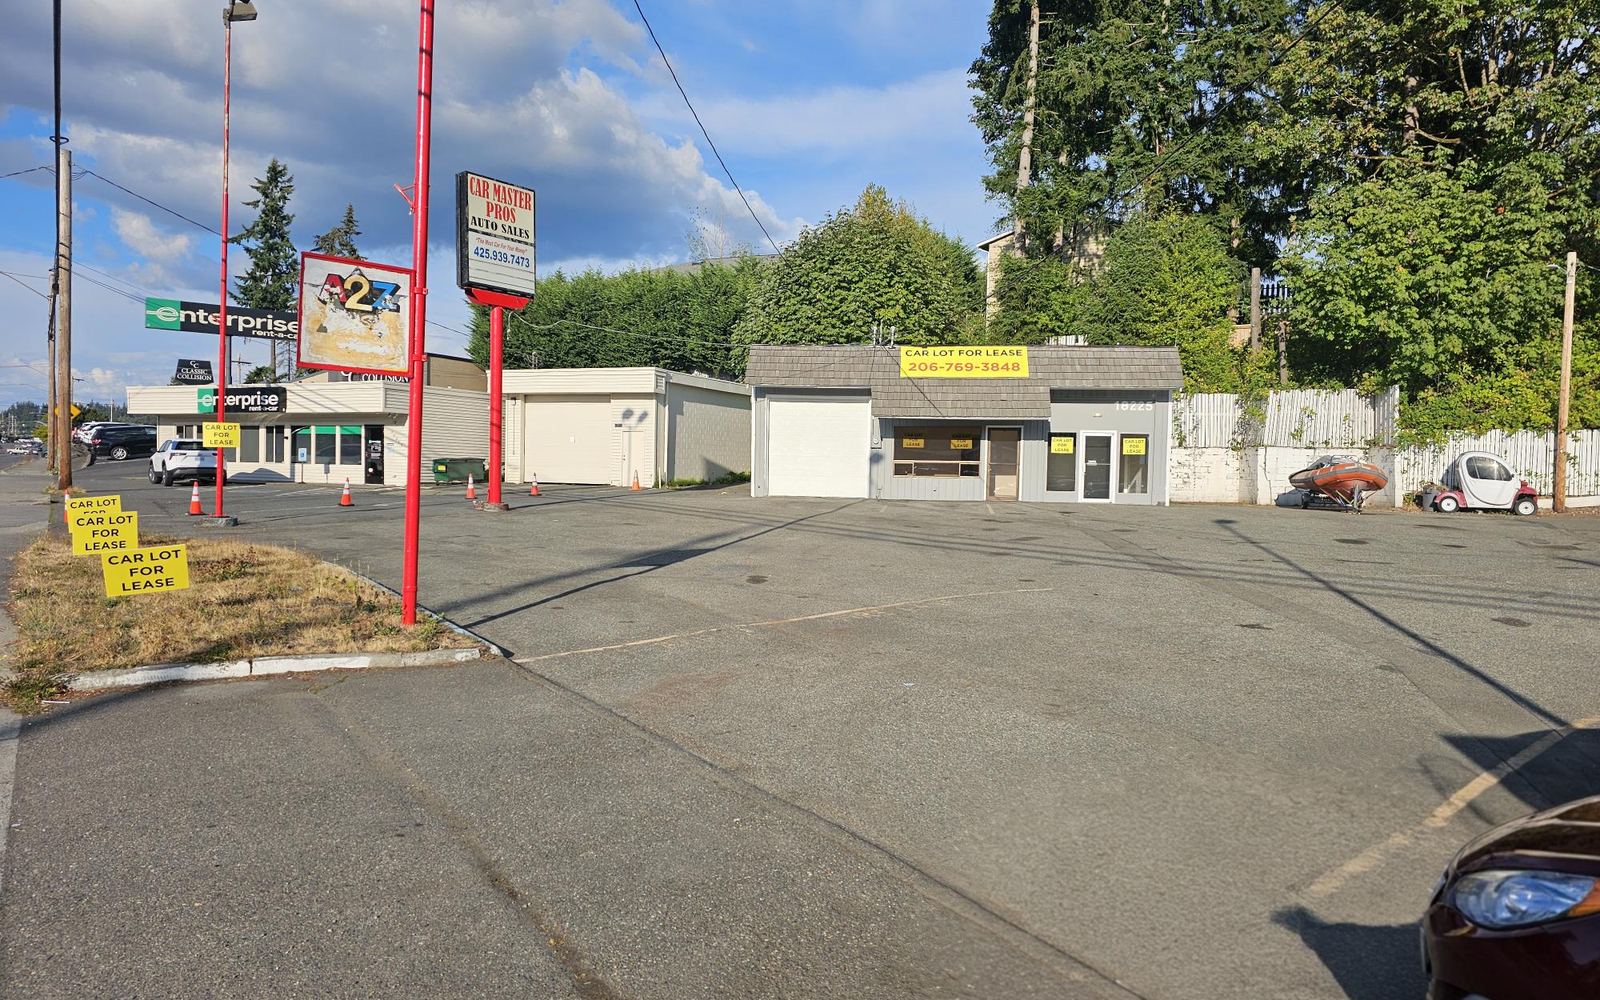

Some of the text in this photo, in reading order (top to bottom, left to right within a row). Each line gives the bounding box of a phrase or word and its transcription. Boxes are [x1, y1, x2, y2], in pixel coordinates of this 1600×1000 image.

[469, 176, 532, 211] CAR MASTER
[486, 201, 516, 223] PROS
[470, 216, 530, 239] AUTO SALES
[473, 246, 530, 268] 425.939.7473
[156, 306, 298, 334] enterprise
[252, 329, 298, 340] rent-a-ca
[905, 349, 1023, 357] CAR LOT FOR LEASE
[908, 362, 1021, 372] 206-769-3848
[177, 373, 212, 381] COLLISION
[202, 391, 279, 410] enerprise
[1114, 400, 1153, 411] 18225
[70, 498, 117, 509] CAR LOT
[76, 515, 133, 526] CAR LOT
[92, 529, 119, 538] FOR
[85, 540, 126, 551] LEASE
[108, 549, 181, 565] CAR LOT
[129, 565, 164, 577] FOR
[122, 577, 175, 592] LEASE
